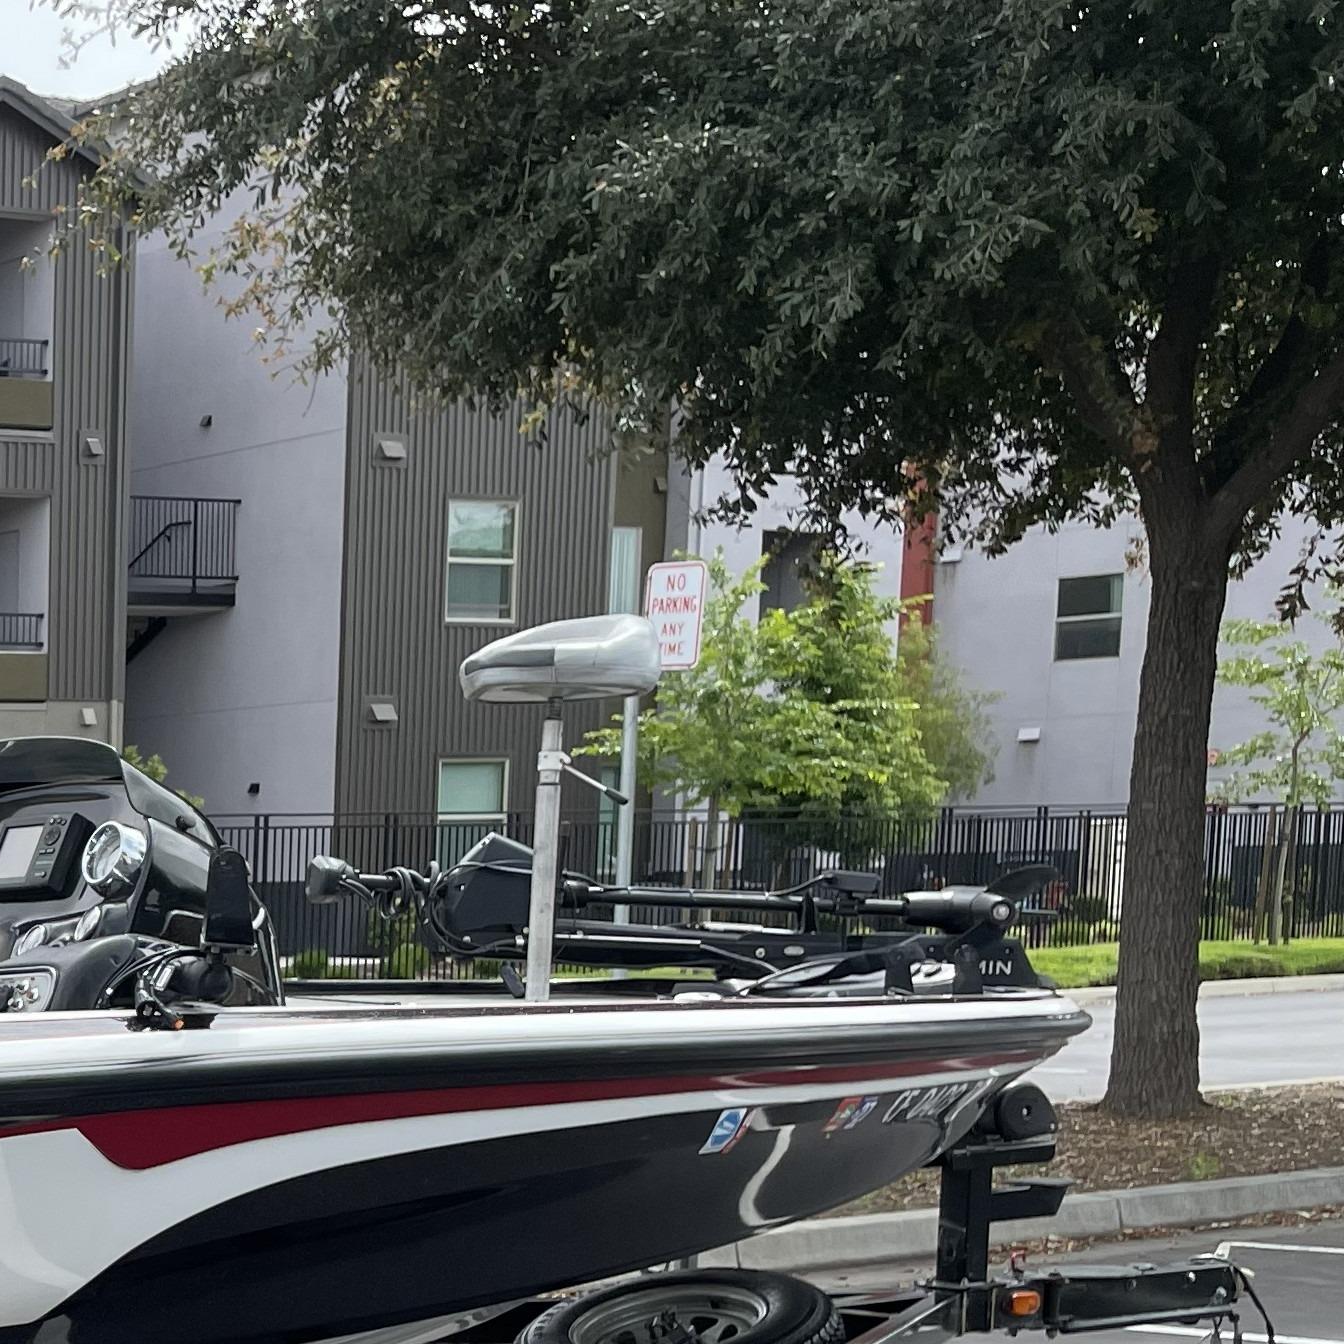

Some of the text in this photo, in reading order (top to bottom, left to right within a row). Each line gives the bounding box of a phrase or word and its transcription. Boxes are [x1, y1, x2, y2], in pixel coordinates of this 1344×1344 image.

[666, 573, 687, 591] NO
[652, 596, 697, 615] PARKING
[661, 622, 685, 637] ANY
